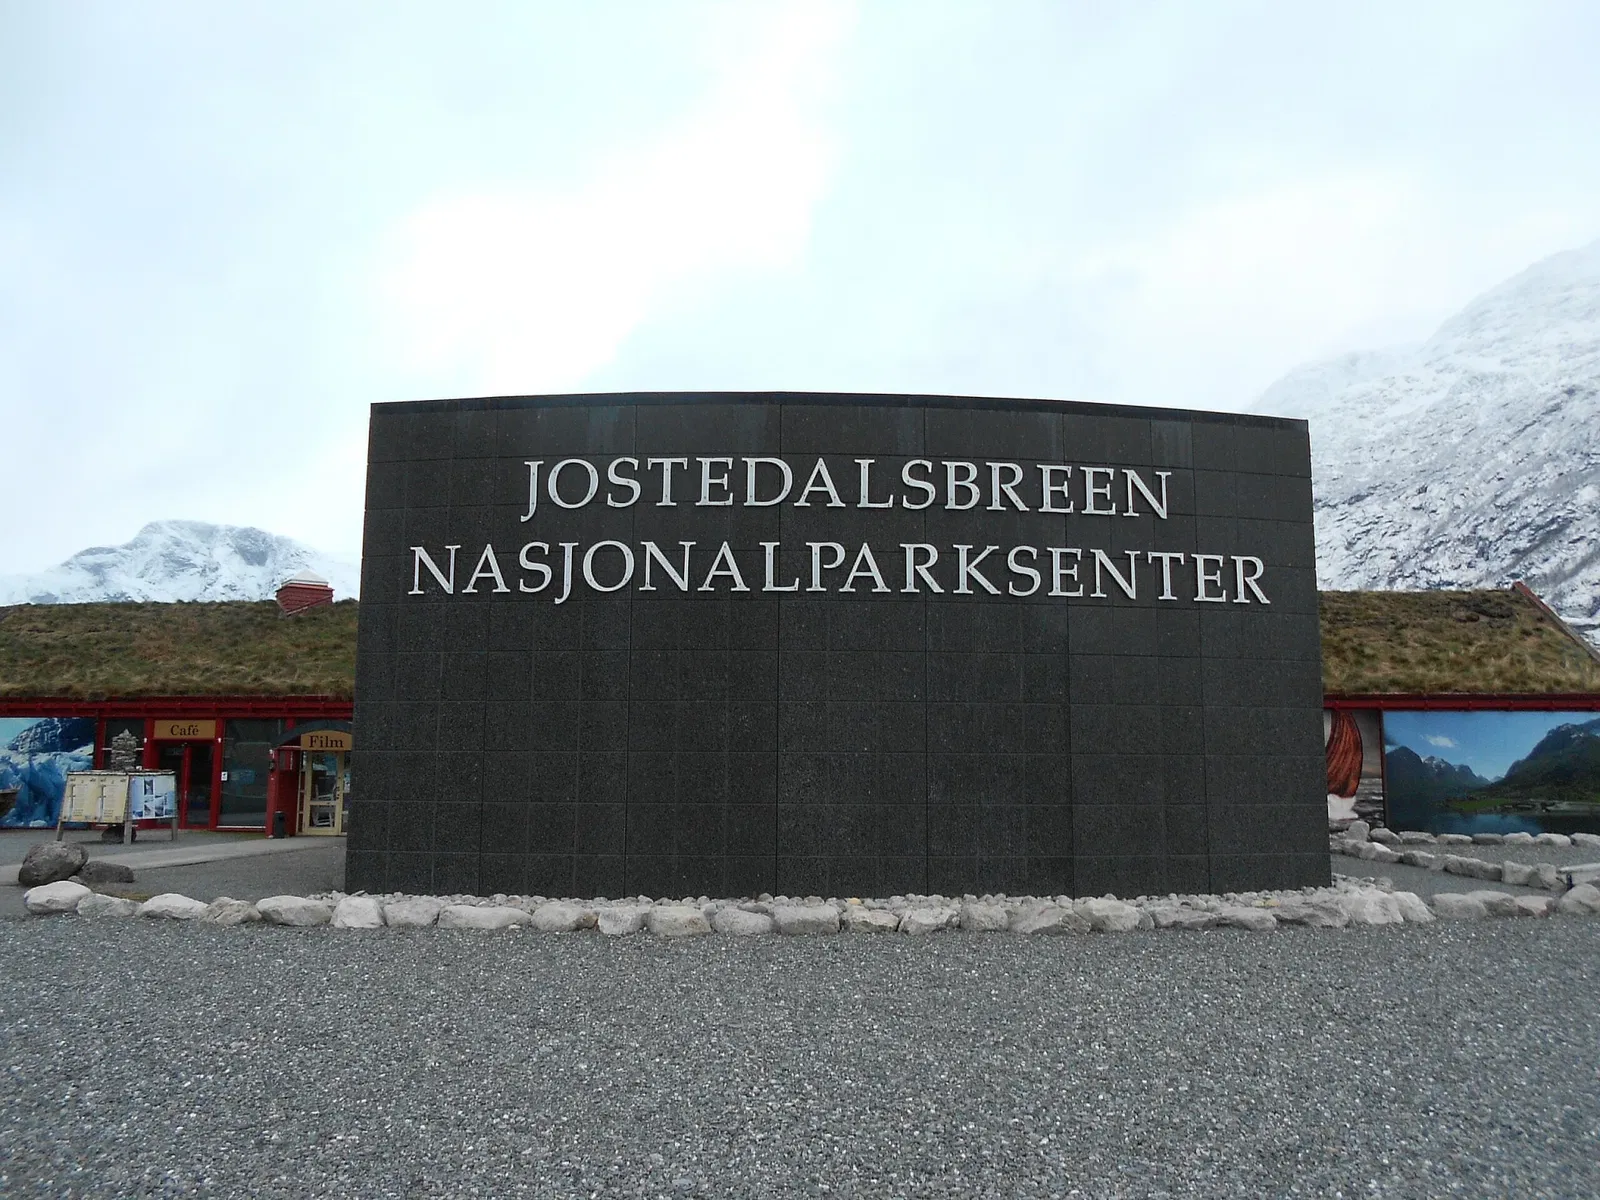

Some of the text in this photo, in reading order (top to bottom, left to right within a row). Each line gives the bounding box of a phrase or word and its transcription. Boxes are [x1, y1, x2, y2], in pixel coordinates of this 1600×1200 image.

[520, 456, 1172, 523] JOSTEDALSBREEN
[407, 540, 1271, 605] NASJONALPARKSENTER
[170, 724, 199, 736] Café
[309, 735, 344, 748] Film
